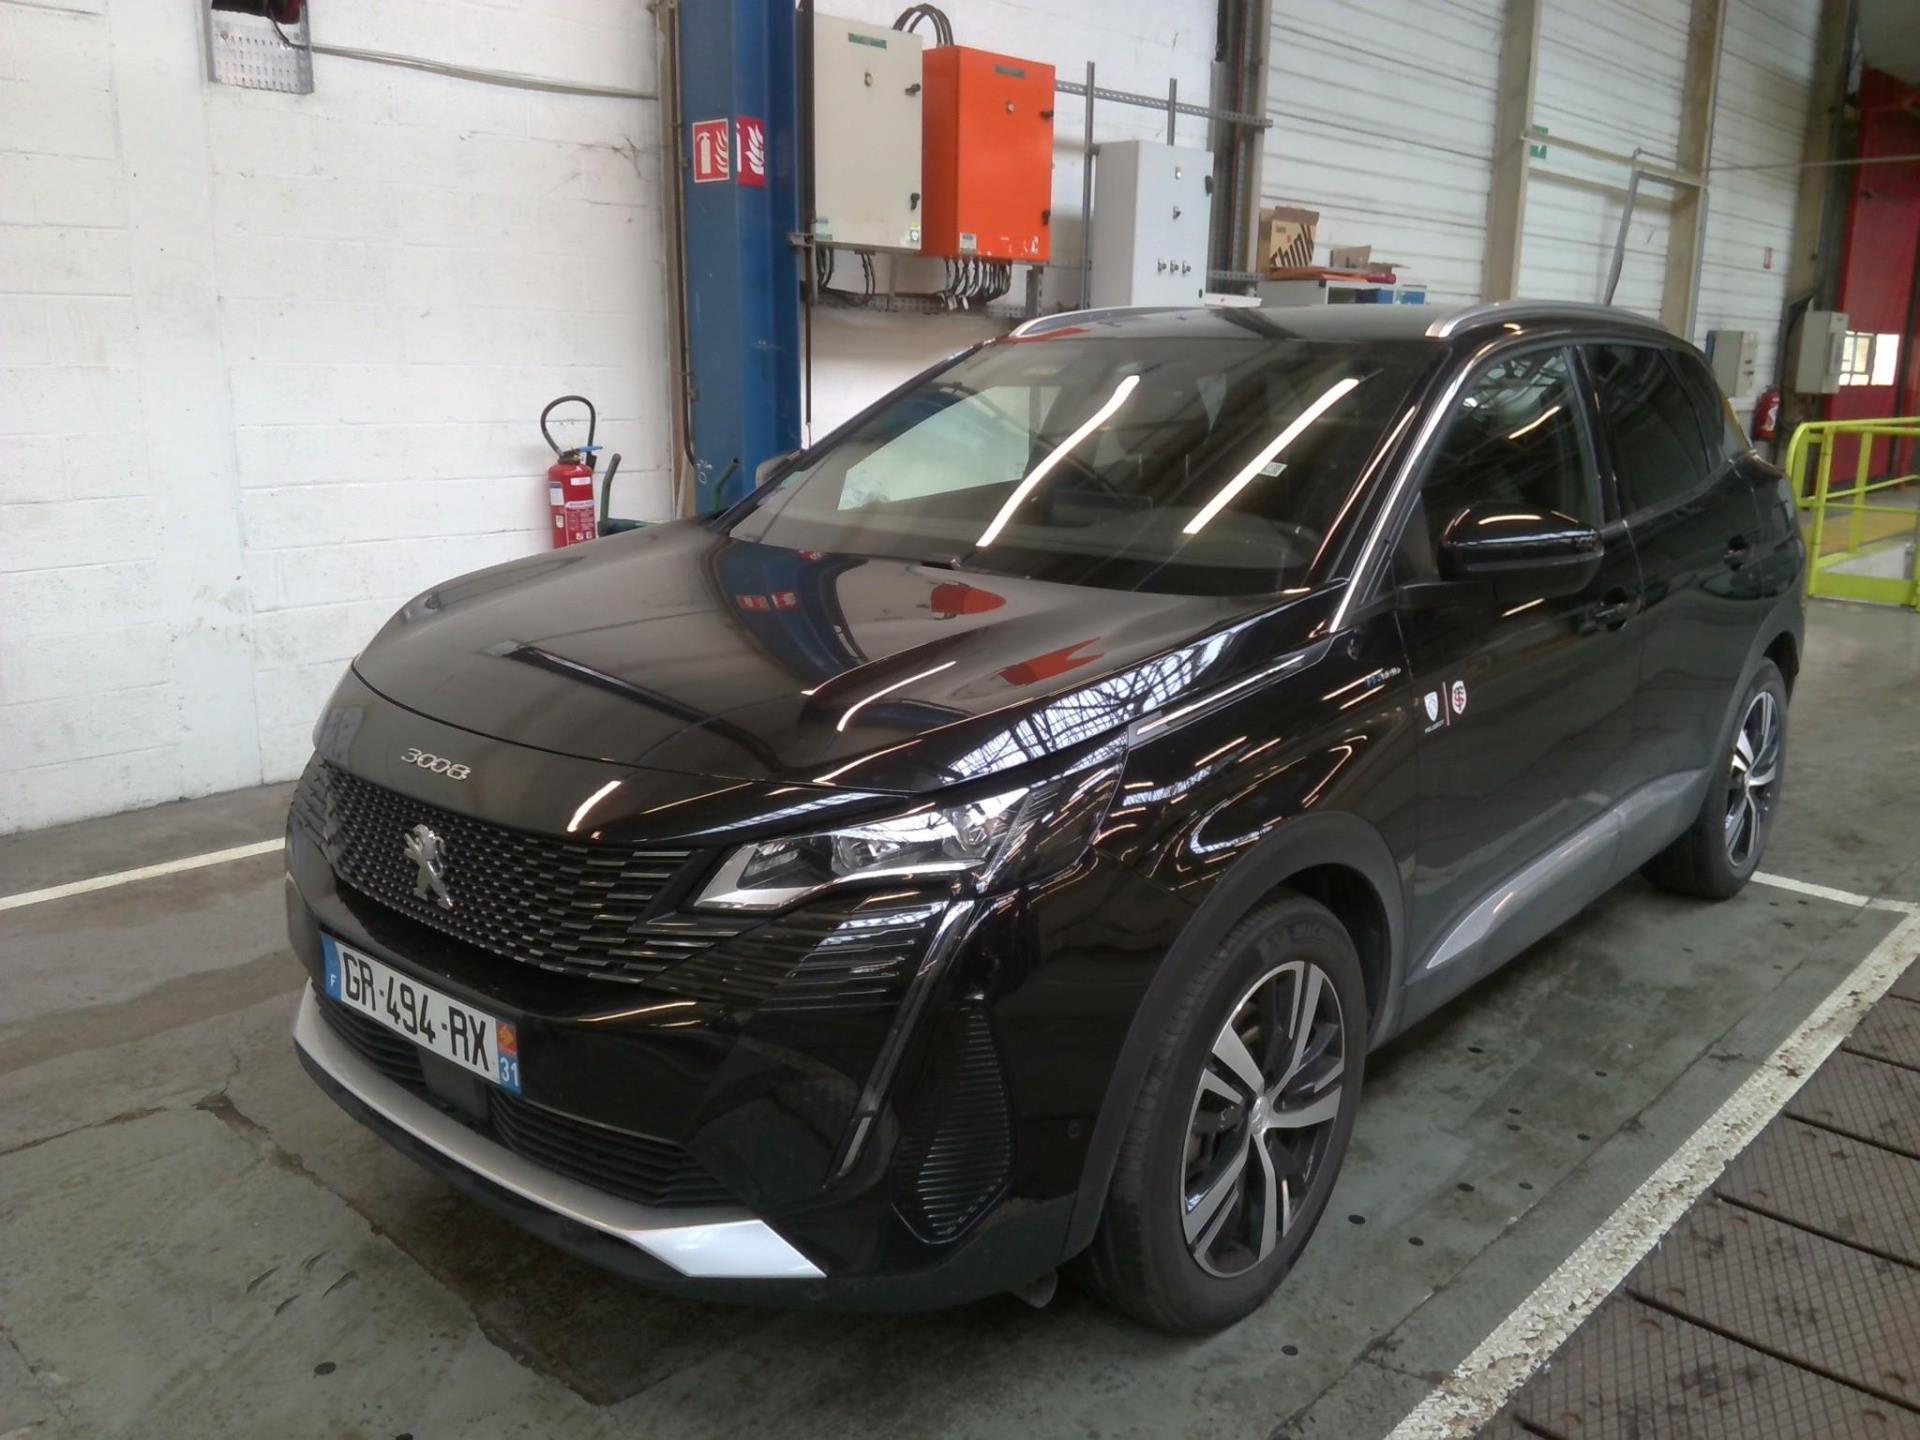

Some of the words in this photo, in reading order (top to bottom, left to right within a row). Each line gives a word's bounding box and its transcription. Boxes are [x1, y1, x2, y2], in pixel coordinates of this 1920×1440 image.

[401, 747, 471, 780] 3008
[329, 974, 337, 988] F
[343, 951, 490, 1073] GR-494-RX
[499, 1057, 520, 1087] 31
